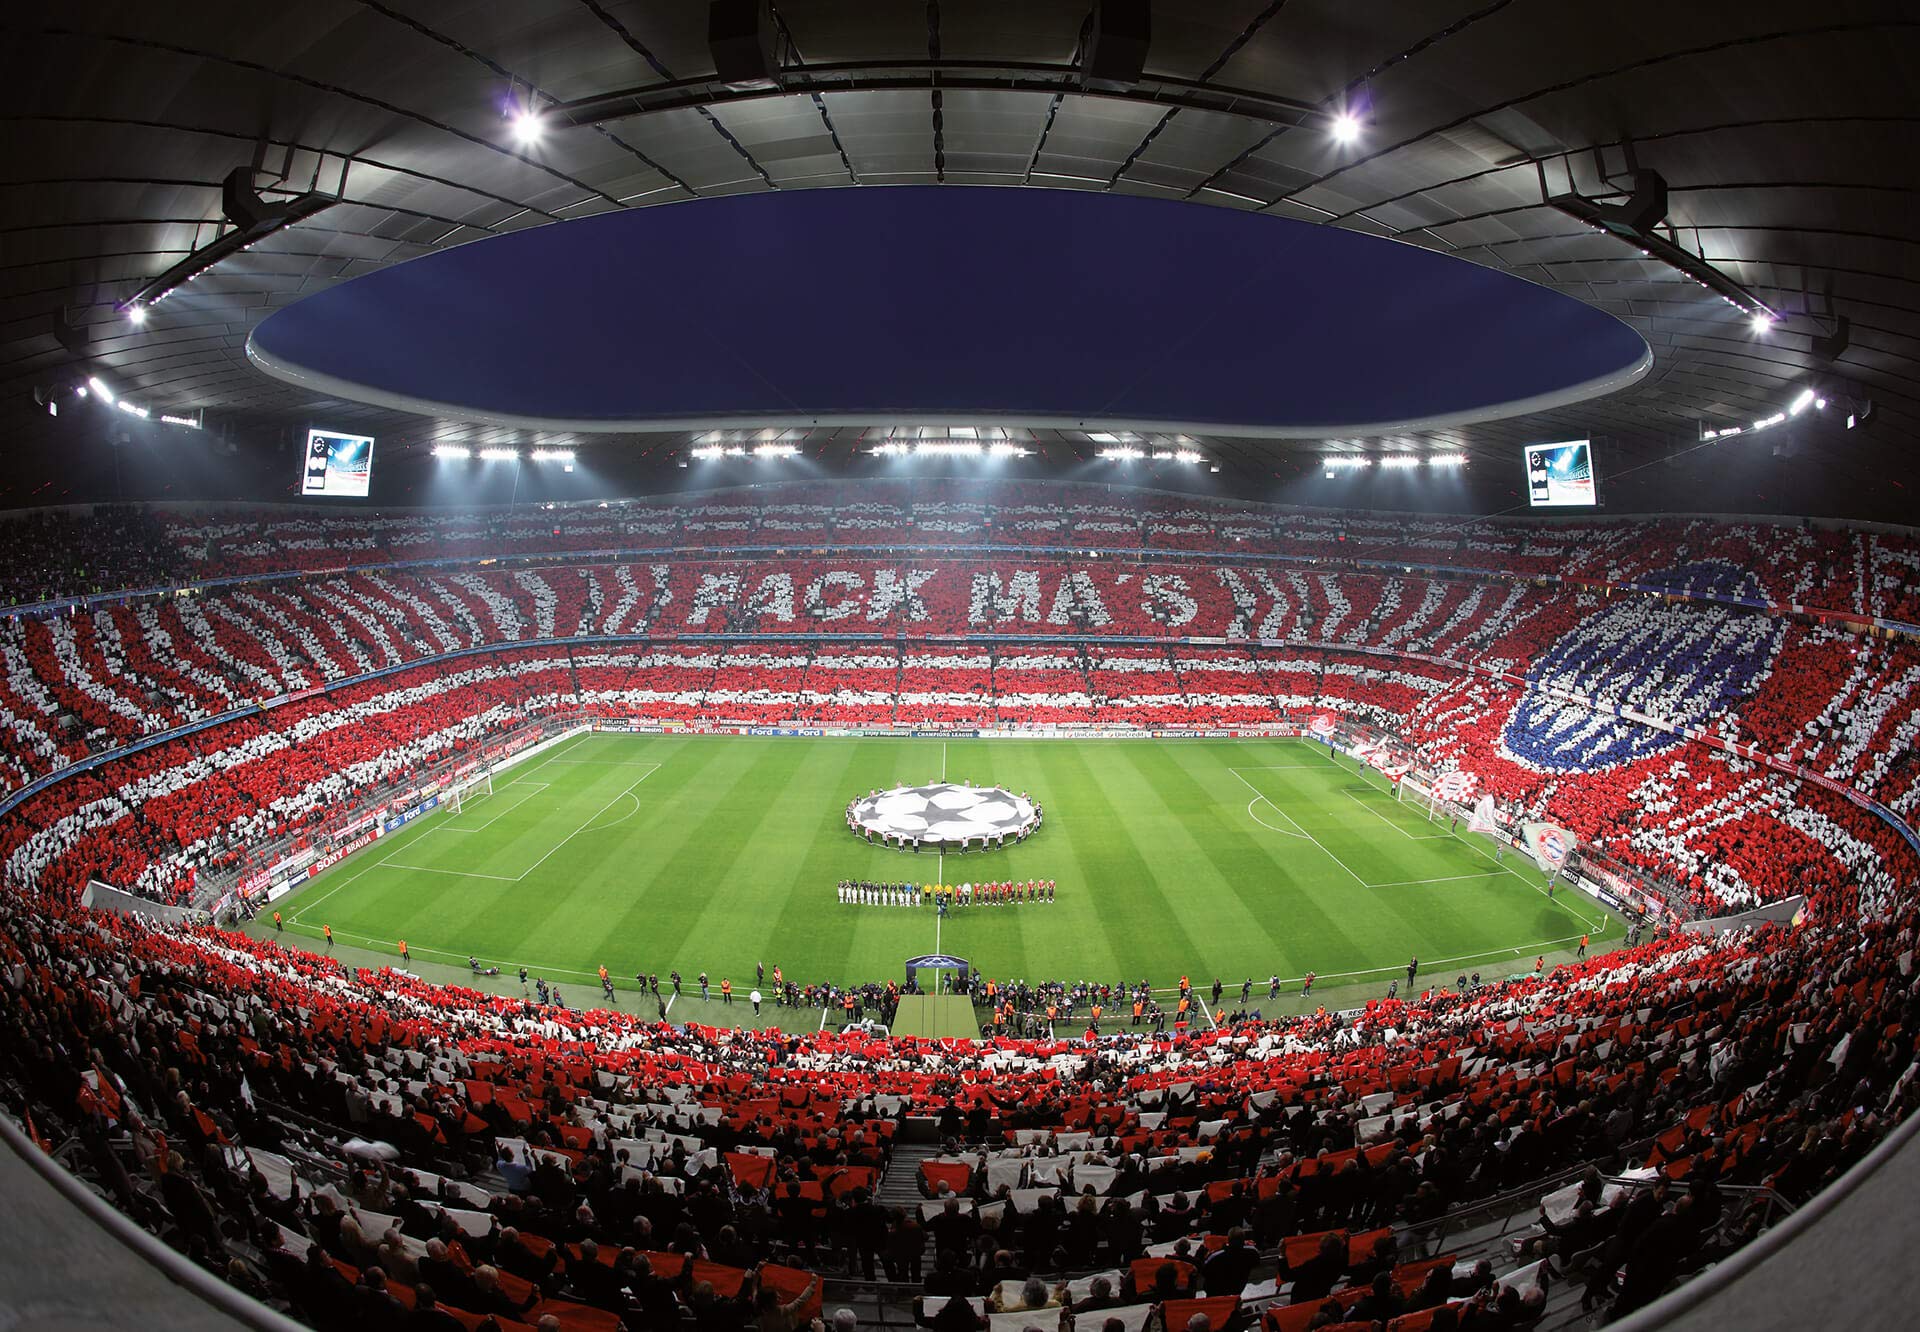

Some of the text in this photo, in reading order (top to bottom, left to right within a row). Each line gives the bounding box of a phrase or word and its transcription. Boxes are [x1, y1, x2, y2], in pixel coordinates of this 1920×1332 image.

[687, 569, 938, 624] PACK
[1332, 741, 1345, 753] Ford
[404, 806, 421, 822] Ford
[316, 851, 344, 872] SONY
[346, 834, 372, 854] BRAVIA
